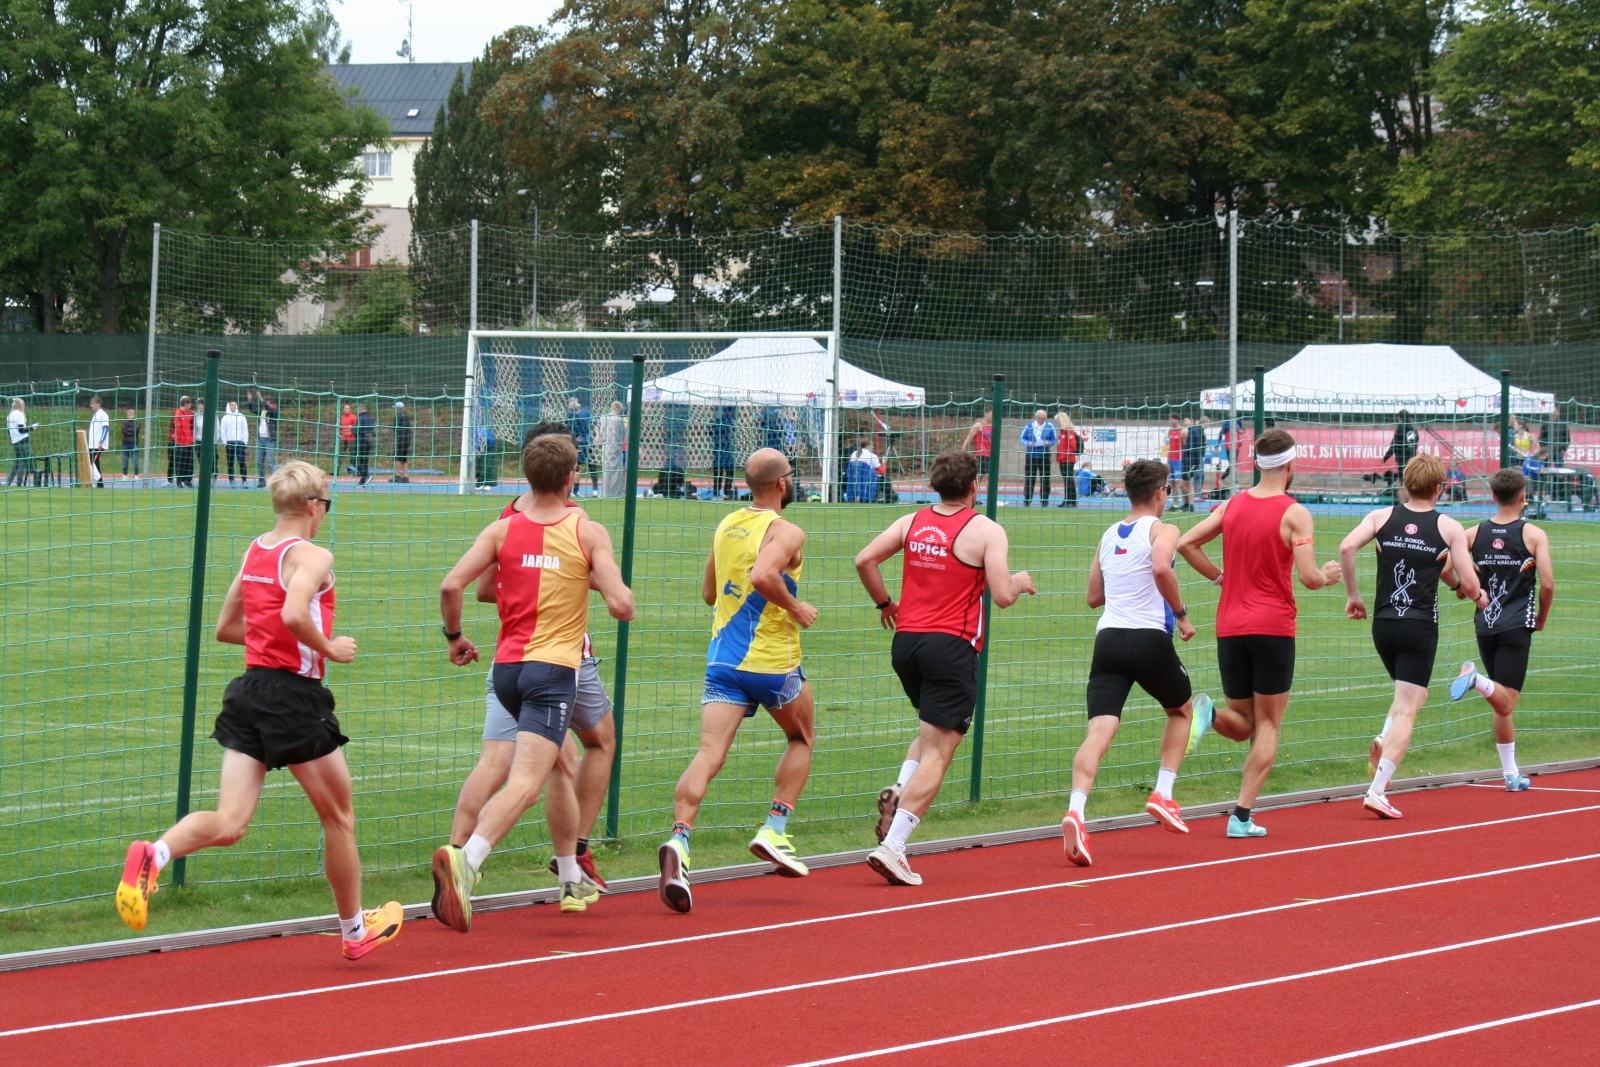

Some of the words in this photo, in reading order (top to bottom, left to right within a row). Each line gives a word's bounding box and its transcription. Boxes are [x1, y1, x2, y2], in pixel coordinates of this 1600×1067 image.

[1382, 541, 1407, 549] HRADEC
[1404, 536, 1426, 546] SOKOL
[521, 553, 560, 570] JARDA
